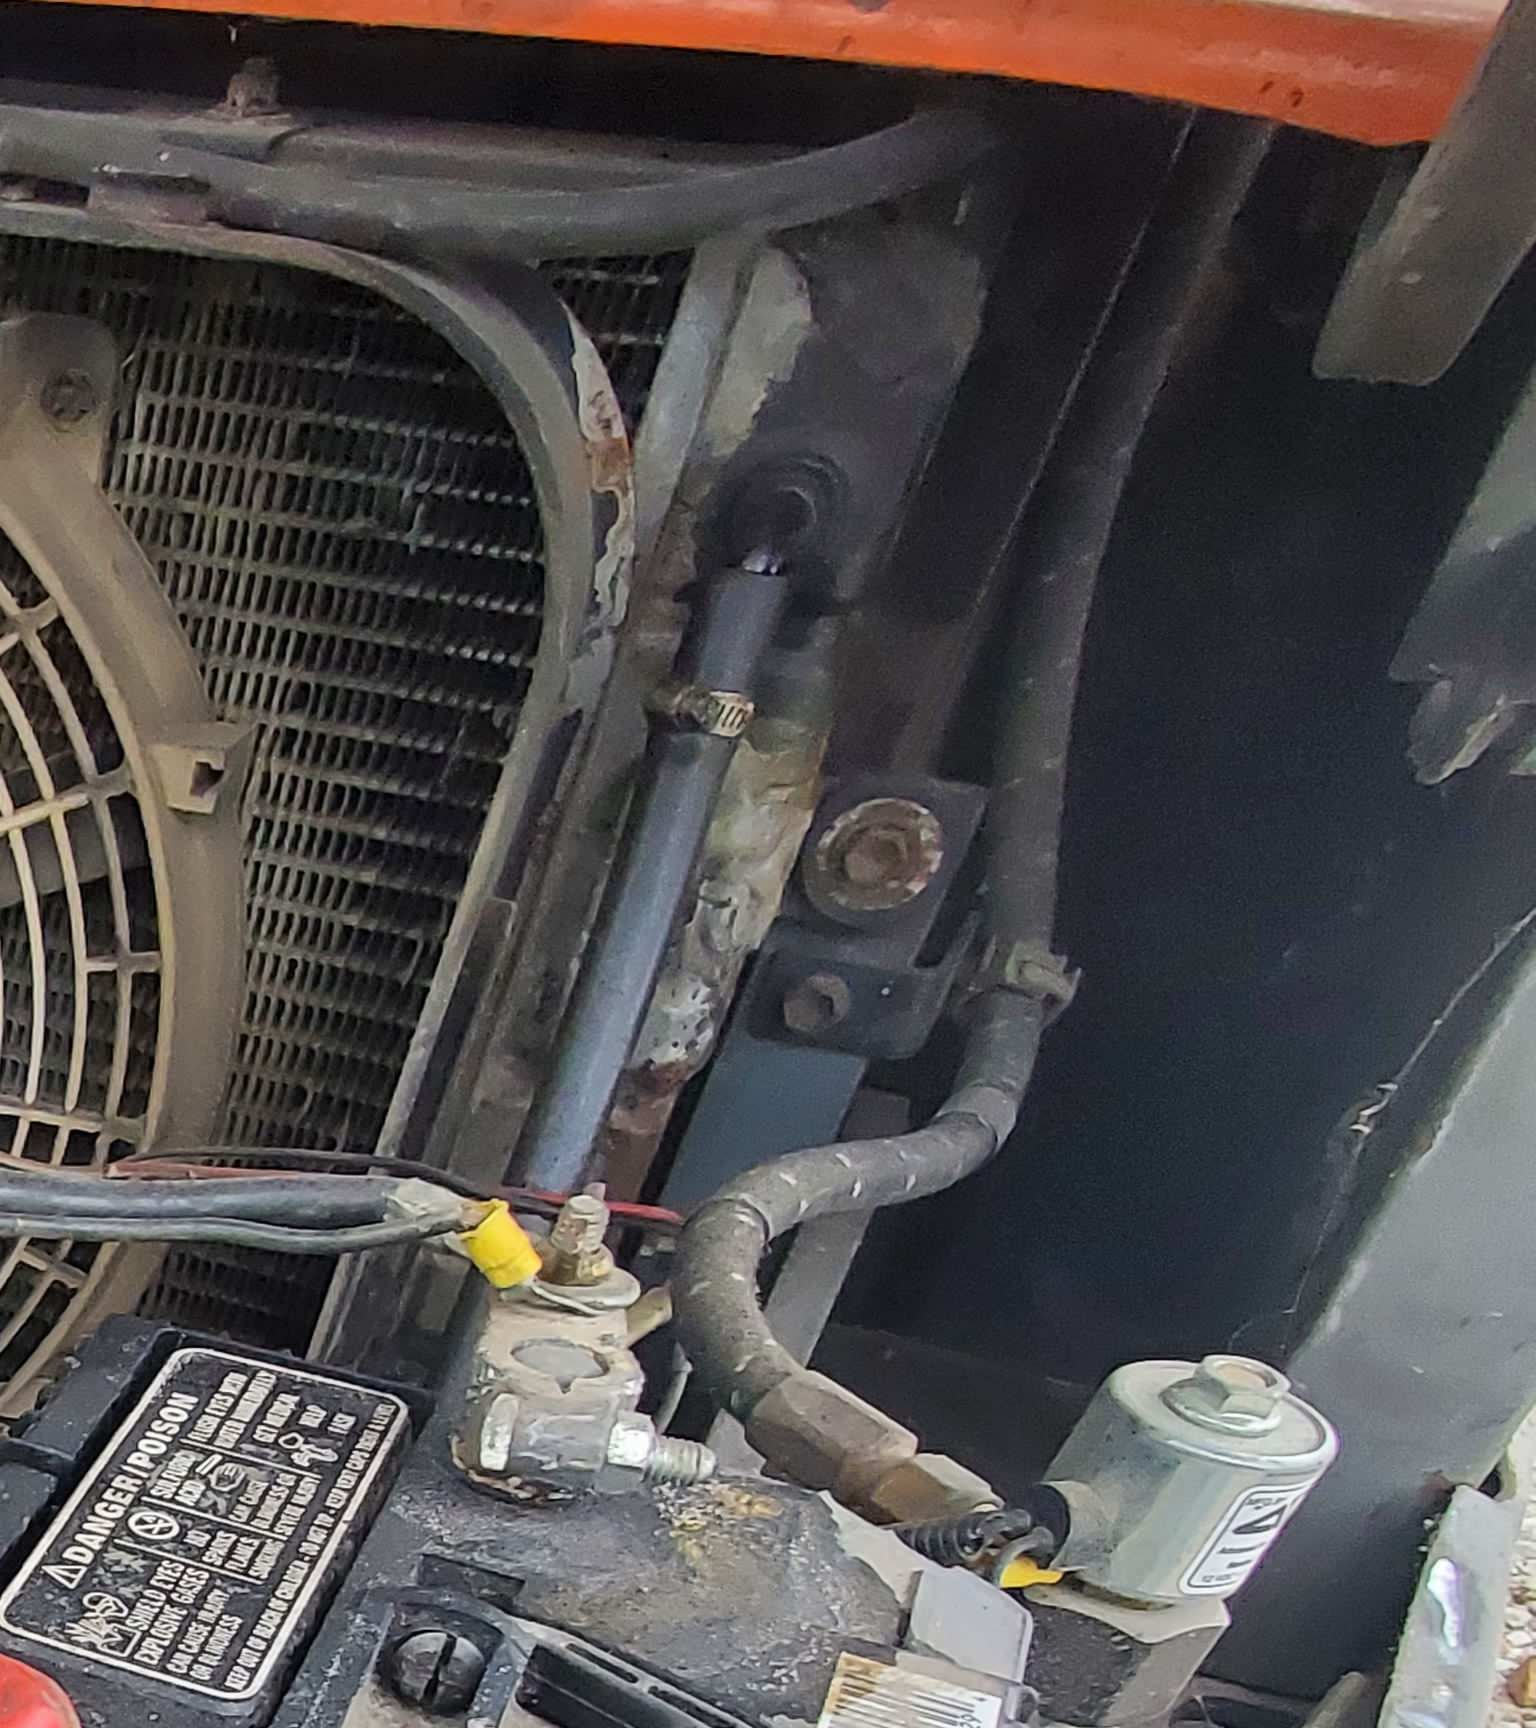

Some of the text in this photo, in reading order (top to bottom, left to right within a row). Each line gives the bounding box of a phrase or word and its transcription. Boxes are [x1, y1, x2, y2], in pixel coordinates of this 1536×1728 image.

[204, 1393, 235, 1417] EYES
[62, 1391, 199, 1565] DANGER/POISON
[174, 1479, 206, 1507] ACID
[228, 1503, 252, 1523] CAN
[183, 1529, 212, 1548] NO
[201, 1530, 239, 1566] SPARKS
[224, 1536, 263, 1573] FLAMES
[247, 1538, 285, 1580] SMOKING
[124, 1559, 185, 1631] SHIELD EYES
[133, 1567, 210, 1666] EXPLOSIVE GASES
[166, 1588, 235, 1674] CAN CAUSE INJURY
[252, 1608, 284, 1639] REACH
[189, 1614, 244, 1681] OR BLINDNESS
[236, 1647, 262, 1668] OUT
[246, 1635, 268, 1651] OF
[224, 1665, 251, 1691] KEEP
